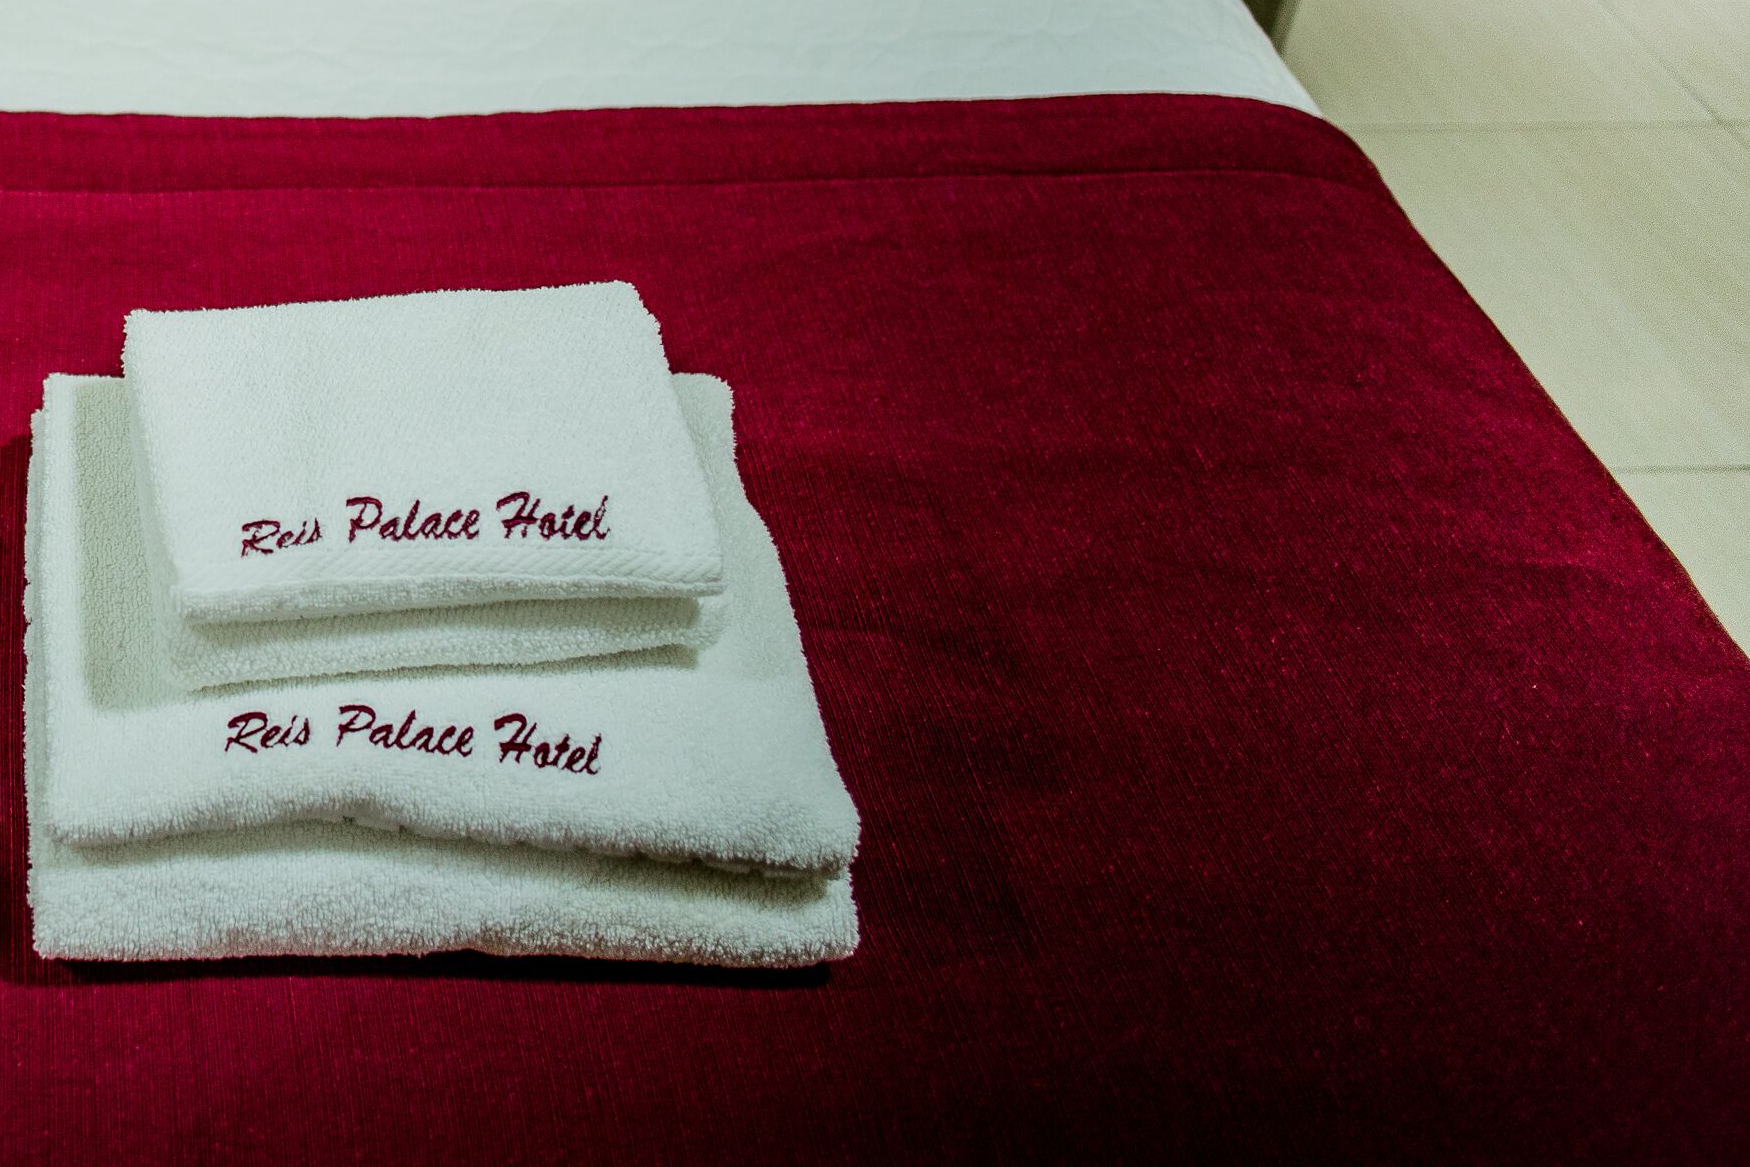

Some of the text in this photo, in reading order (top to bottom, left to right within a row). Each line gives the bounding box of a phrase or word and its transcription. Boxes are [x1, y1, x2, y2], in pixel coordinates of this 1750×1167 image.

[241, 491, 610, 557] Reis Palace Hotel
[225, 705, 602, 775] Reis Palace Hotel
